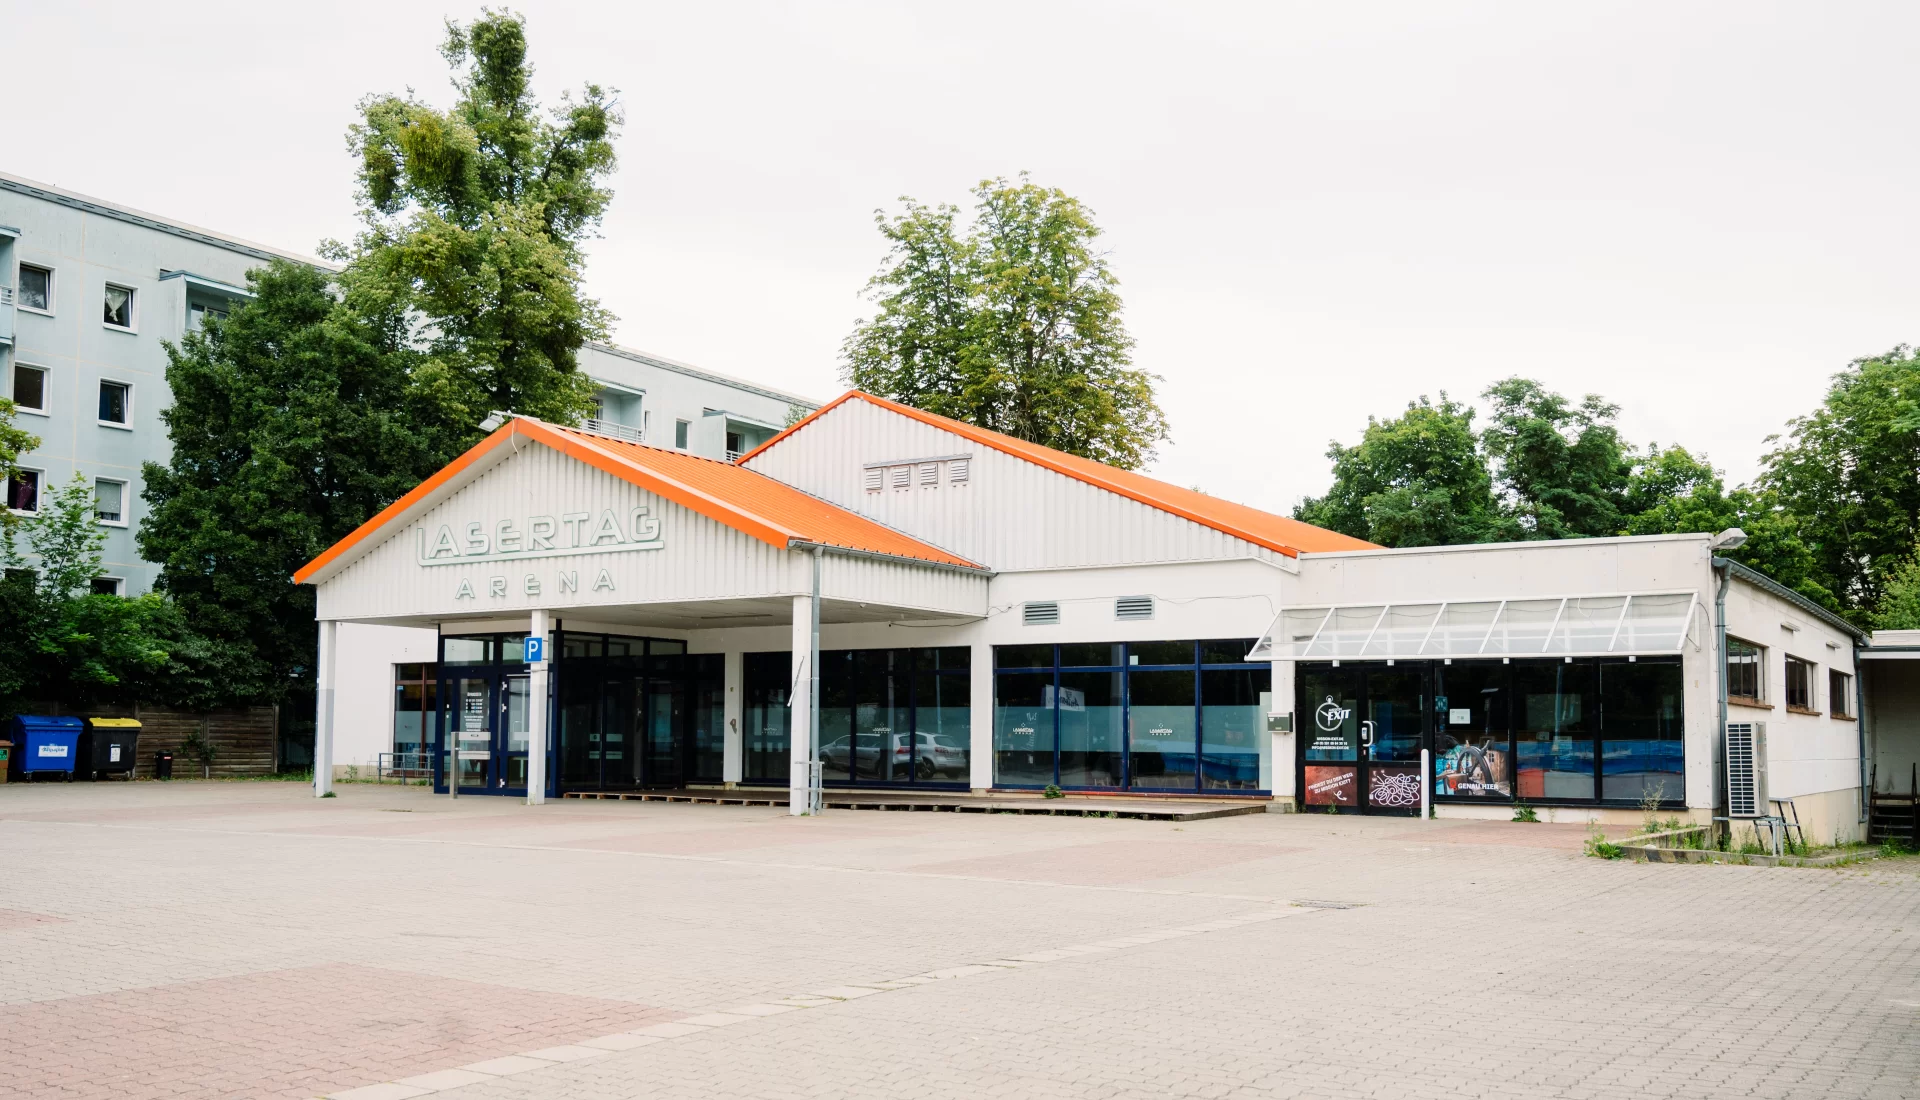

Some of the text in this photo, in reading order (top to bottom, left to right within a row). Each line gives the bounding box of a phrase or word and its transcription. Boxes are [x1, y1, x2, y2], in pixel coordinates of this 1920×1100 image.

[417, 506, 664, 567] LASERTAG
[455, 568, 616, 599] ARENA
[528, 640, 539, 660] P
[1328, 709, 1351, 720] EXIT
